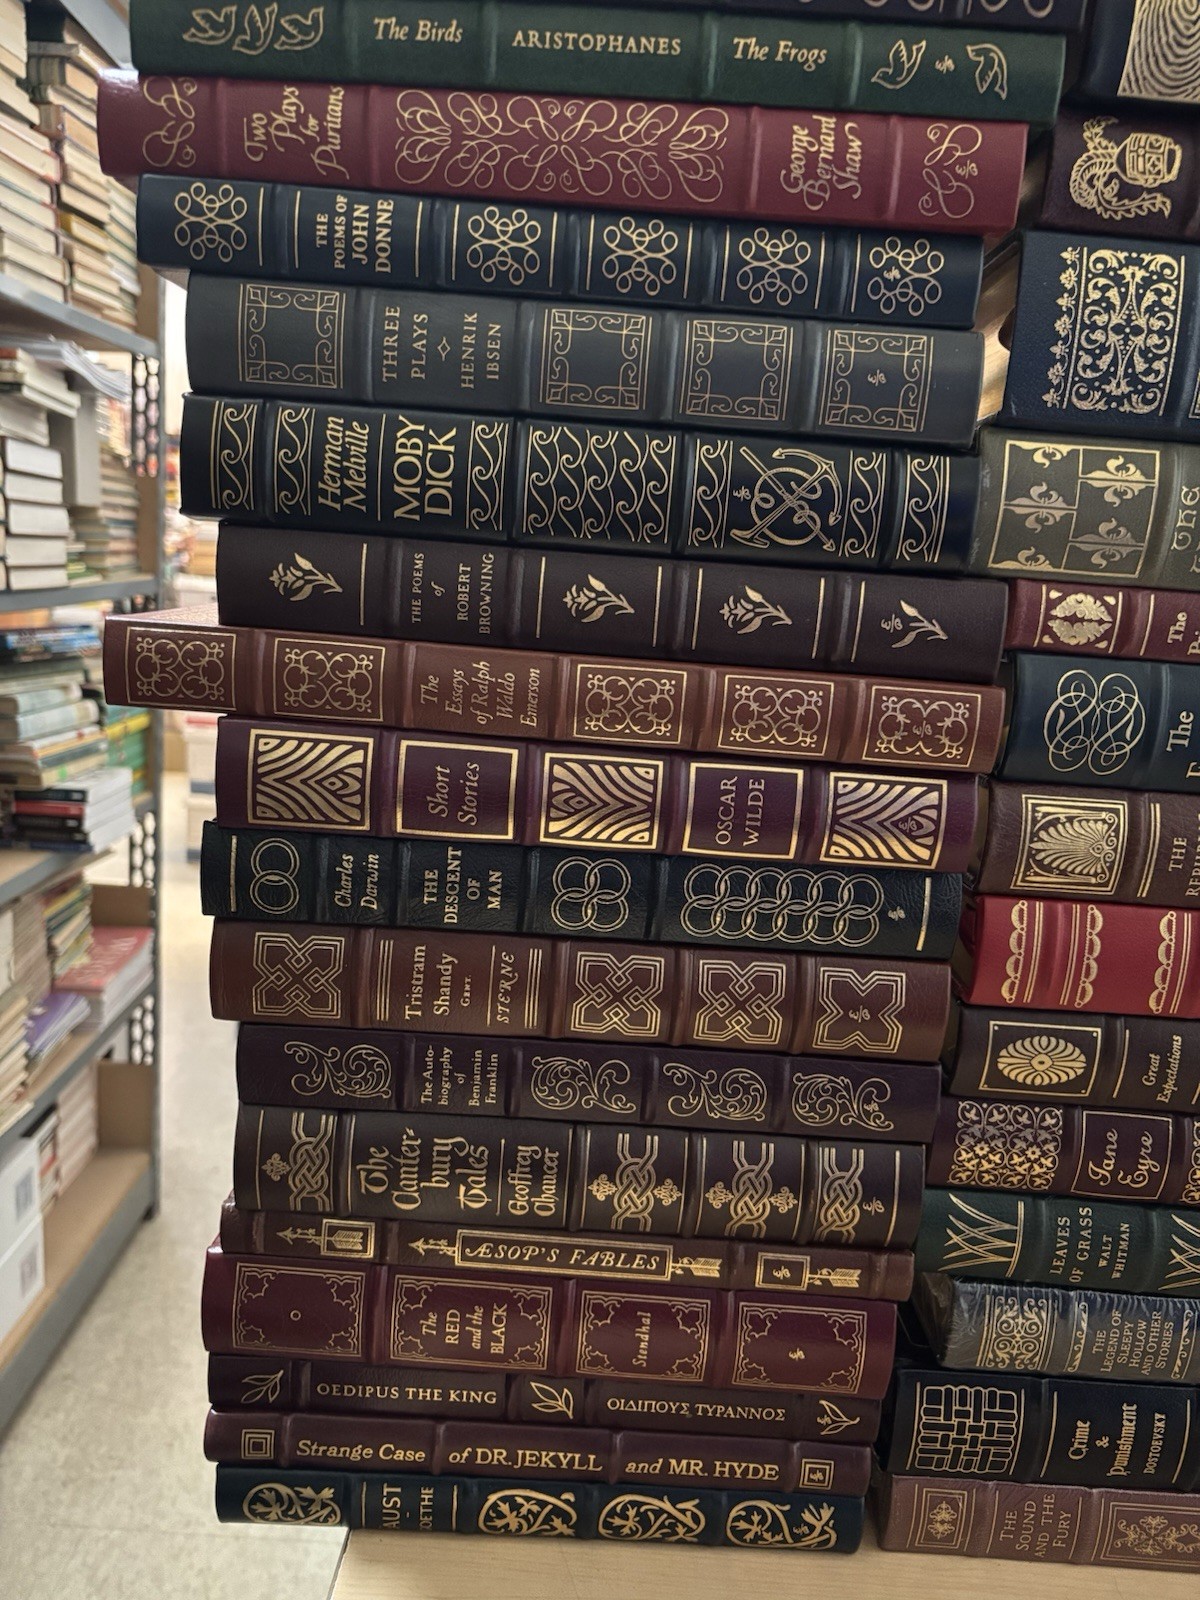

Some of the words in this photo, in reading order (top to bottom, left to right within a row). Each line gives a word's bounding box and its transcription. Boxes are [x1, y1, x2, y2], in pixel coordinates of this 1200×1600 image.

[373, 17, 413, 41] The
[417, 21, 463, 43] Birds
[512, 30, 681, 55] ARISTOPHANES
[733, 37, 770, 62] The
[774, 41, 827, 71] Frogs
[244, 112, 268, 161] Two
[269, 85, 304, 152] Plays
[301, 113, 319, 141] for
[311, 86, 349, 179] Puritans
[780, 124, 807, 194] George
[802, 115, 836, 210] Bernard
[846, 122, 863, 199] Shaw
[336, 194, 348, 214] OF
[316, 213, 328, 247] THE
[334, 218, 347, 270] POEMS
[352, 203, 370, 265] JOHN
[374, 199, 394, 274] DONNE
[382, 305, 400, 382] THREE
[410, 312, 429, 379] PLAYS
[460, 312, 478, 389] HENRIK
[486, 323, 502, 380] IBSEN
[317, 416, 345, 512] Herman
[343, 421, 370, 513] Melville
[392, 414, 425, 521] MOBY
[424, 427, 457, 517] DICK
[412, 553, 425, 594] POEMS
[431, 581, 446, 597] of
[457, 563, 471, 622] ROBERT
[479, 552, 495, 634] BROWNING
[412, 599, 422, 623] THE
[1167, 611, 1188, 644] The
[420, 675, 440, 704] The
[445, 669, 470, 715] Essays
[471, 661, 496, 706] Ralph
[496, 672, 516, 719] Waldo
[520, 668, 541, 727] Emerson
[470, 707, 493, 725] of
[1166, 710, 1194, 752] The
[426, 765, 451, 818] Short
[457, 761, 480, 826] Stories
[715, 775, 738, 845] OSCAR
[743, 778, 765, 846] WILDE
[1168, 837, 1187, 872] THE
[334, 853, 354, 907] Charles
[361, 853, 380, 910] Darwin
[424, 869, 439, 905] THE
[443, 846, 462, 924] DESCENT
[467, 878, 481, 901] OF
[487, 870, 502, 910] MAN
[405, 945, 427, 1021] Tristram
[433, 953, 459, 1016] Shandy
[496, 951, 519, 1024] STERNE
[422, 1044, 435, 1080] Auto-
[438, 1046, 453, 1106] biography
[454, 1072, 467, 1084] of
[468, 1050, 483, 1107] Benjamin
[485, 1053, 499, 1104] Franklin
[1142, 1052, 1161, 1086] Great
[1156, 1034, 1183, 1104] Expectations
[421, 1084, 433, 1104] The
[356, 1145, 389, 1195] The
[420, 1136, 470, 1190] bury
[455, 1144, 492, 1210] Tales
[507, 1144, 541, 1216] Geoffrey
[1088, 1128, 1119, 1187] Jane
[1117, 1131, 1160, 1188] Eyre
[530, 1147, 560, 1217] Chaucer
[1050, 1216, 1070, 1275] LEAVES
[1076, 1207, 1092, 1261] GRASS
[1098, 1235, 1112, 1268] WALT
[1111, 1222, 1130, 1280] WHITMAN
[570, 1249, 661, 1271] FABLES
[1069, 1268, 1085, 1283] OF
[421, 1312, 438, 1337] The
[445, 1309, 461, 1344] RED
[466, 1305, 484, 1325] the
[466, 1326, 481, 1350] and
[491, 1302, 508, 1354] BLACK
[1146, 1311, 1162, 1352] OTHER
[633, 1312, 652, 1367] Stendhal
[1092, 1330, 1107, 1354] THE
[1101, 1328, 1120, 1373] LEGEND
[1111, 1309, 1122, 1327] OF
[1117, 1322, 1134, 1364] SLEEPY
[1129, 1319, 1147, 1367] HOLLOW
[1155, 1321, 1174, 1369] STORIES
[1141, 1353, 1155, 1376] AND
[316, 1382, 399, 1399] OEDIPUS
[404, 1388, 443, 1401] THE
[449, 1389, 497, 1404] KING
[296, 1439, 373, 1460] Strange
[379, 1444, 426, 1462] Case
[449, 1447, 473, 1465] of
[513, 1450, 603, 1472] JEKYLL
[1068, 1419, 1091, 1460] Crime
[1095, 1435, 1110, 1448] &
[1143, 1412, 1166, 1475] DOSTOEVSKY
[625, 1458, 663, 1475] and
[667, 1458, 708, 1477] MR.
[712, 1462, 780, 1481] HYDE
[382, 1482, 401, 1529] AUST
[419, 1487, 434, 1530] OETHE
[1000, 1510, 1018, 1541] THE
[1015, 1501, 1036, 1551] SOUND
[1041, 1493, 1056, 1526] THE
[1052, 1511, 1072, 1548] FURY
[1034, 1533, 1049, 1558] AND
